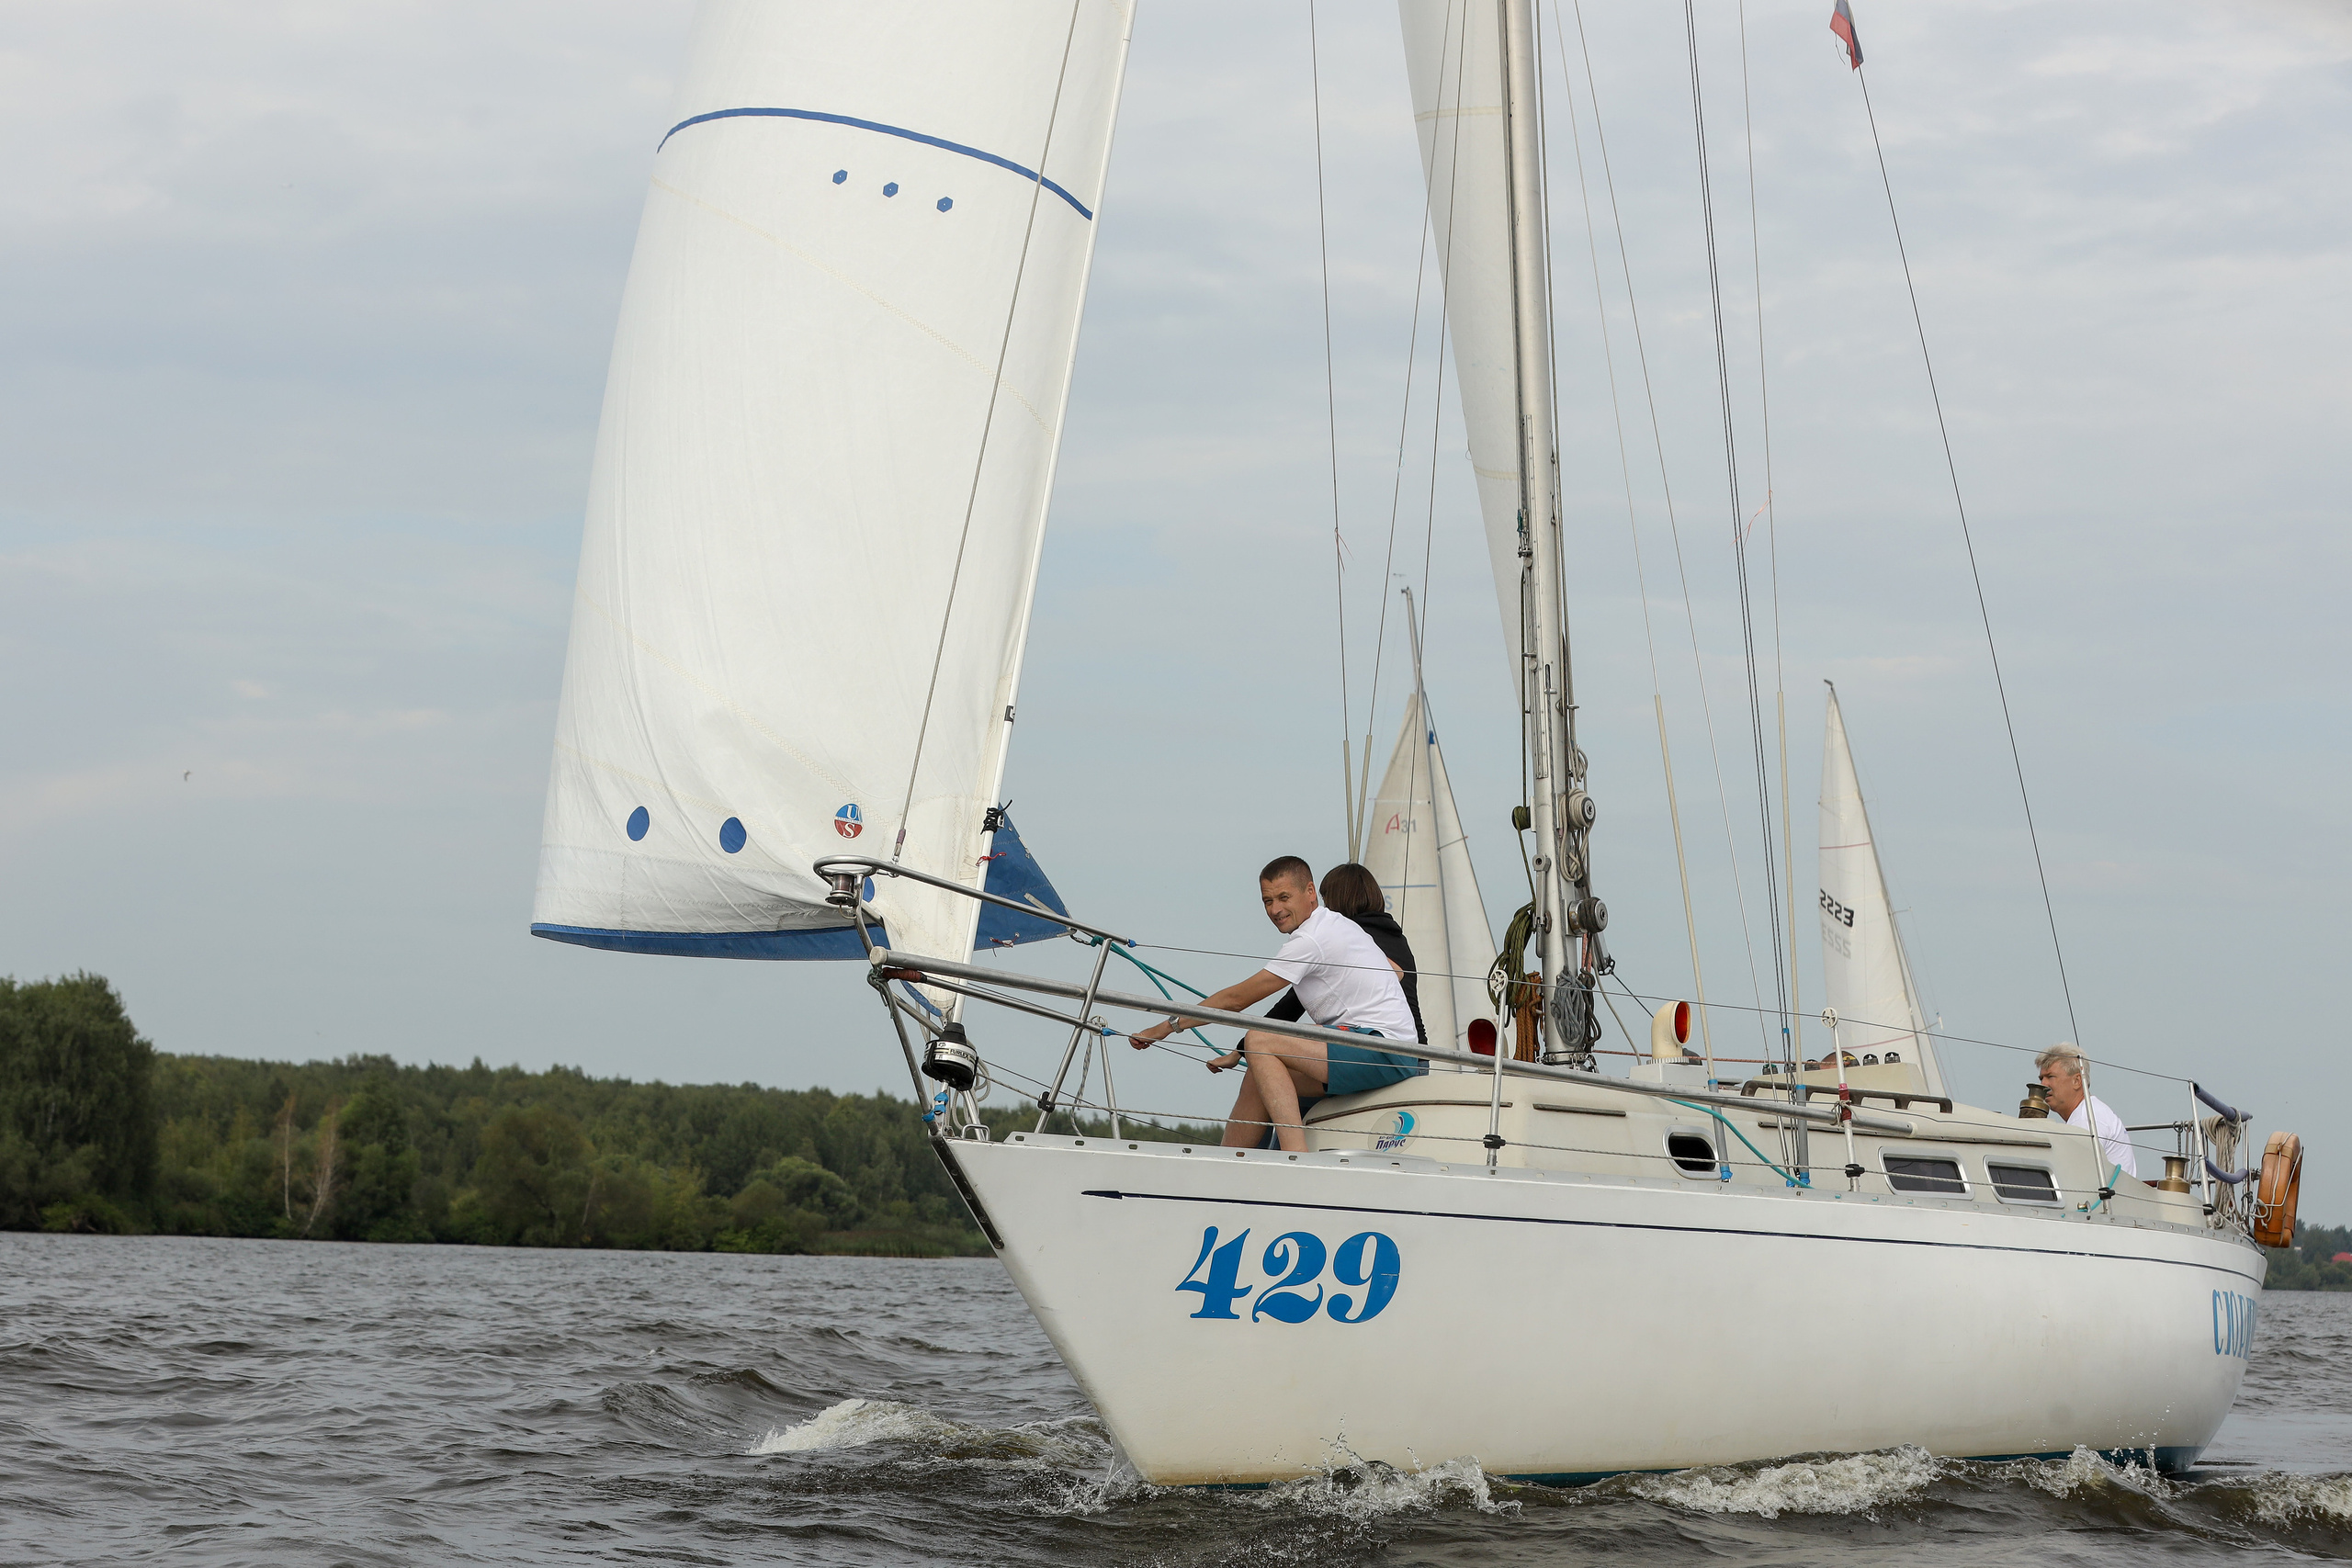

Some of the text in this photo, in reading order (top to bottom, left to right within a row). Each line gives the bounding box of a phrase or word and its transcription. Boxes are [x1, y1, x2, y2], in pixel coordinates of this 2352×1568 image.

[846, 805, 859, 820] U
[842, 823, 855, 838] S
[1819, 888, 1855, 928] 2223
[950, 1049, 969, 1060] FURLEX
[1175, 1225, 1401, 1325] 429
